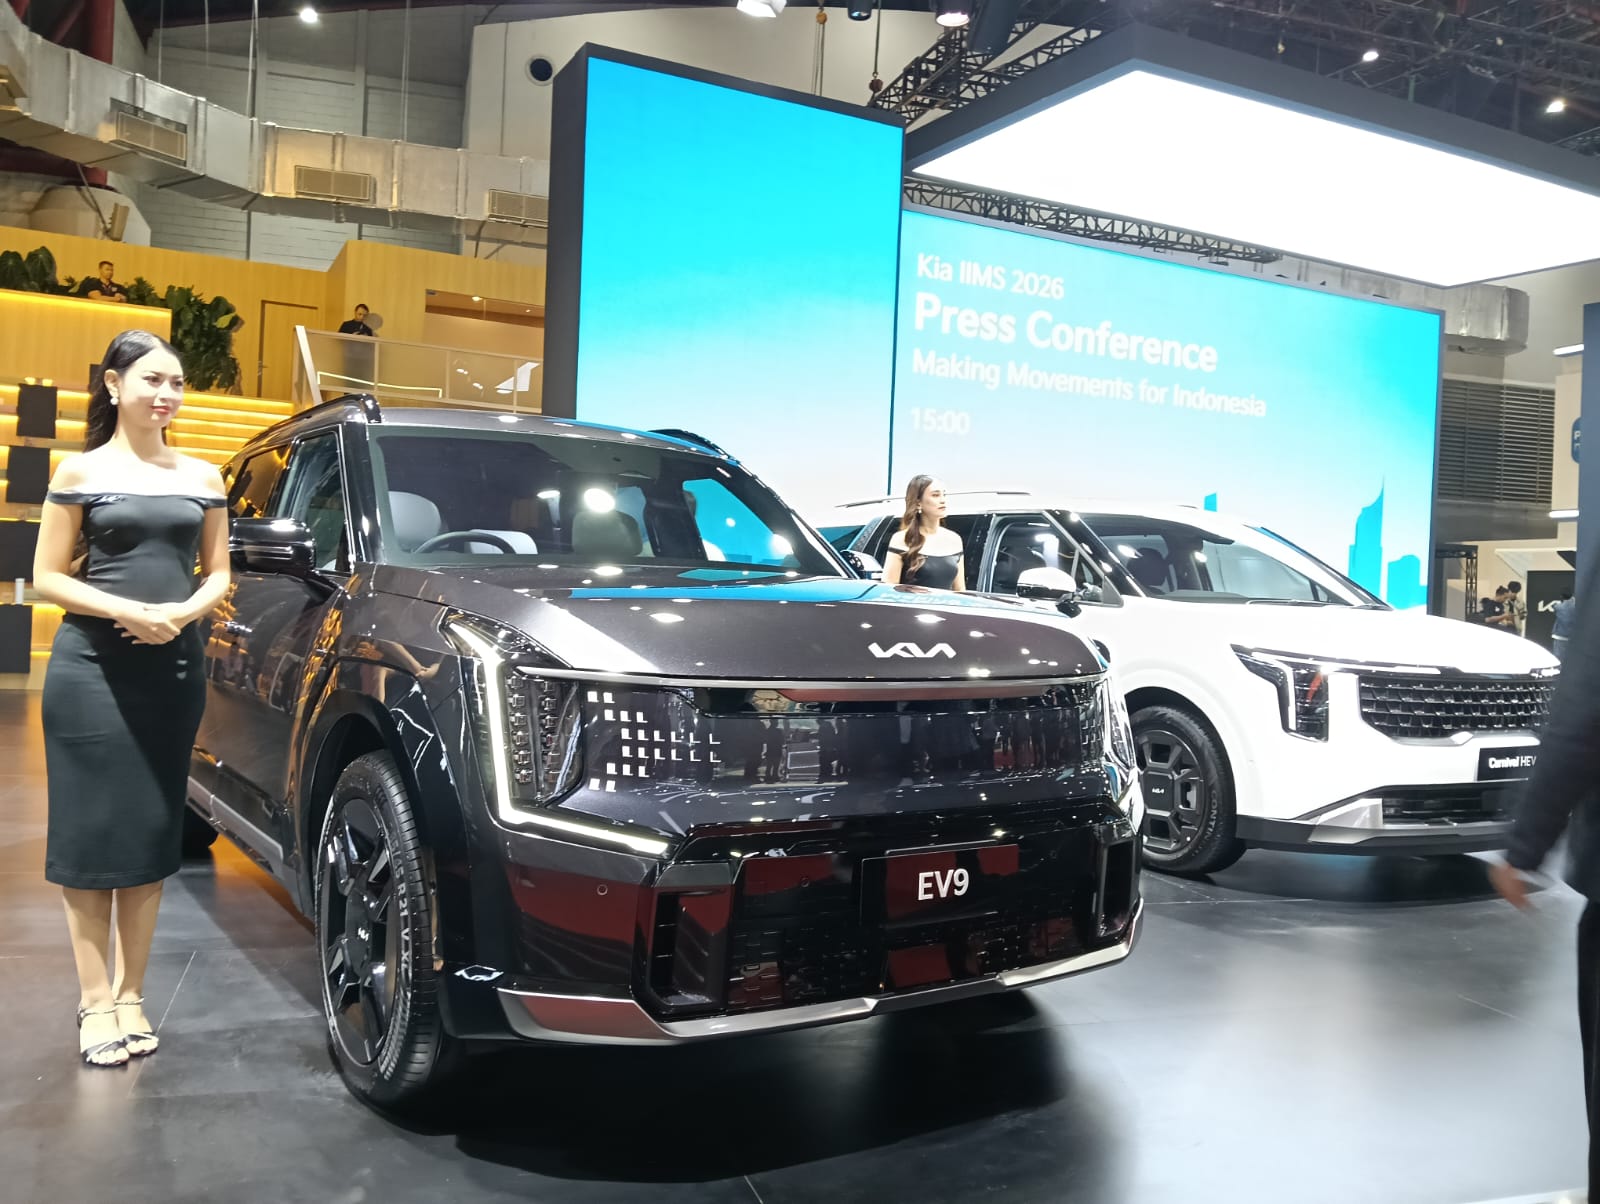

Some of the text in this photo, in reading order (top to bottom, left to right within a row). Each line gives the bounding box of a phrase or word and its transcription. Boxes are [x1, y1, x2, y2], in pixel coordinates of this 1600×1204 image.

[917, 252, 1065, 300] Kia IIMS 2026
[914, 291, 1218, 373] Press Conference
[911, 347, 1267, 417] Making Movements for Indonesia
[909, 406, 971, 435] 15:00
[867, 641, 957, 659] KIA
[1520, 755, 1537, 767] HEV
[918, 868, 970, 901] EV9
